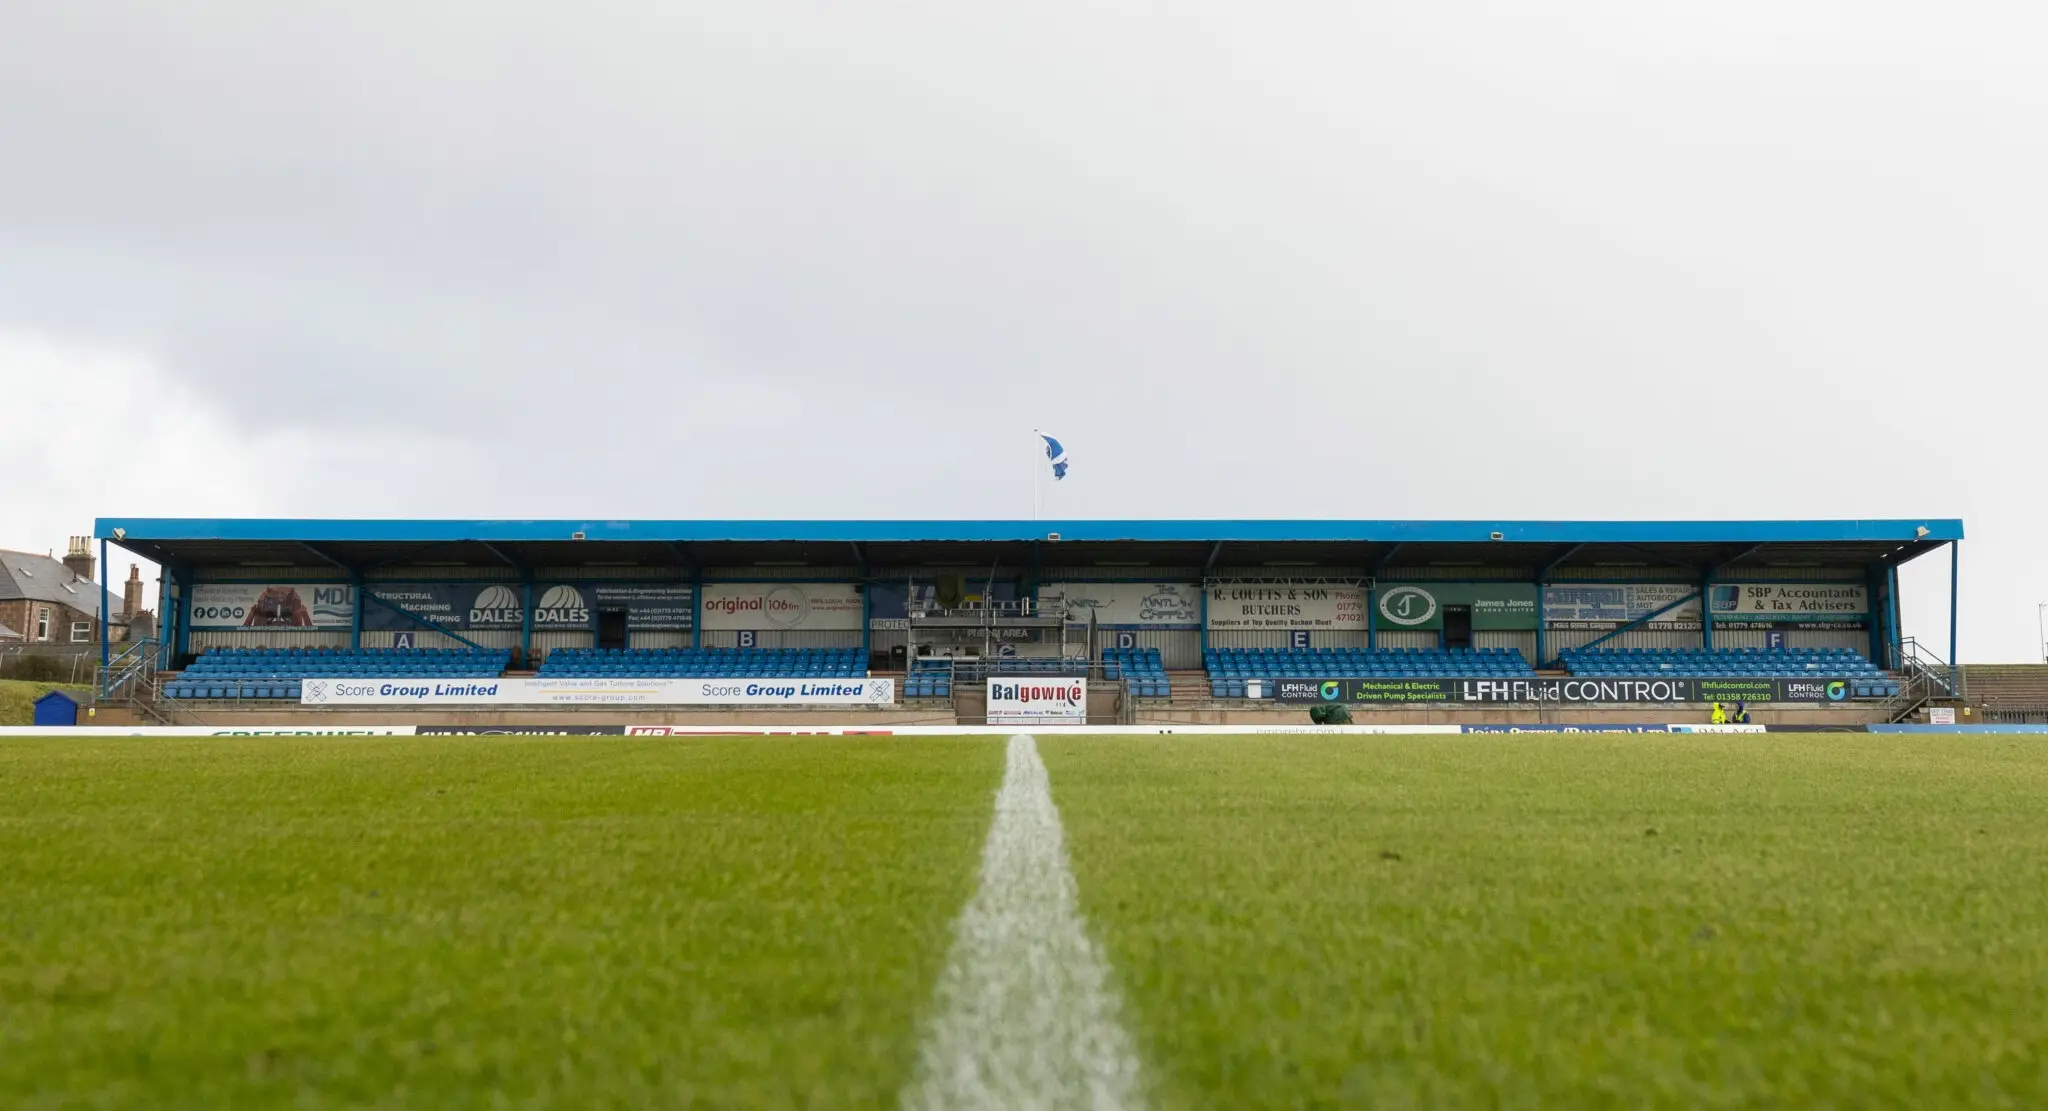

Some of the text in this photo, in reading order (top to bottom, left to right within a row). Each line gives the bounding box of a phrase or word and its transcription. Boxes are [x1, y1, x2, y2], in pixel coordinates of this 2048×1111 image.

[1214, 589, 1328, 600] R. COUTTS & SON
[1747, 588, 1861, 598] SBP Accountants
[705, 597, 762, 614] original
[1475, 599, 1533, 607] James Jones
[1713, 601, 1737, 609] SBP
[1754, 600, 1855, 610] & Tax Advisers
[1242, 605, 1301, 615] BUTCHERS
[430, 614, 460, 622] PIPING
[469, 609, 523, 622] DALES
[535, 609, 589, 622] DALES
[1252, 619, 1263, 627] Top
[1265, 619, 1288, 627] Quality
[1003, 629, 1028, 637] AREA
[397, 634, 410, 648] A
[740, 631, 753, 646] B
[1120, 634, 1132, 648] D
[1294, 632, 1306, 647] E
[1771, 634, 1780, 647] F
[1362, 682, 1440, 690] Mechanical & Electric
[1701, 681, 1771, 689] lfhfluidcontrol.com
[335, 684, 498, 699] Score Group Limited
[702, 684, 863, 699] Score Group Limited
[1356, 692, 1447, 702] Driven Pump Specialists
[1742, 693, 1772, 701] 726310
